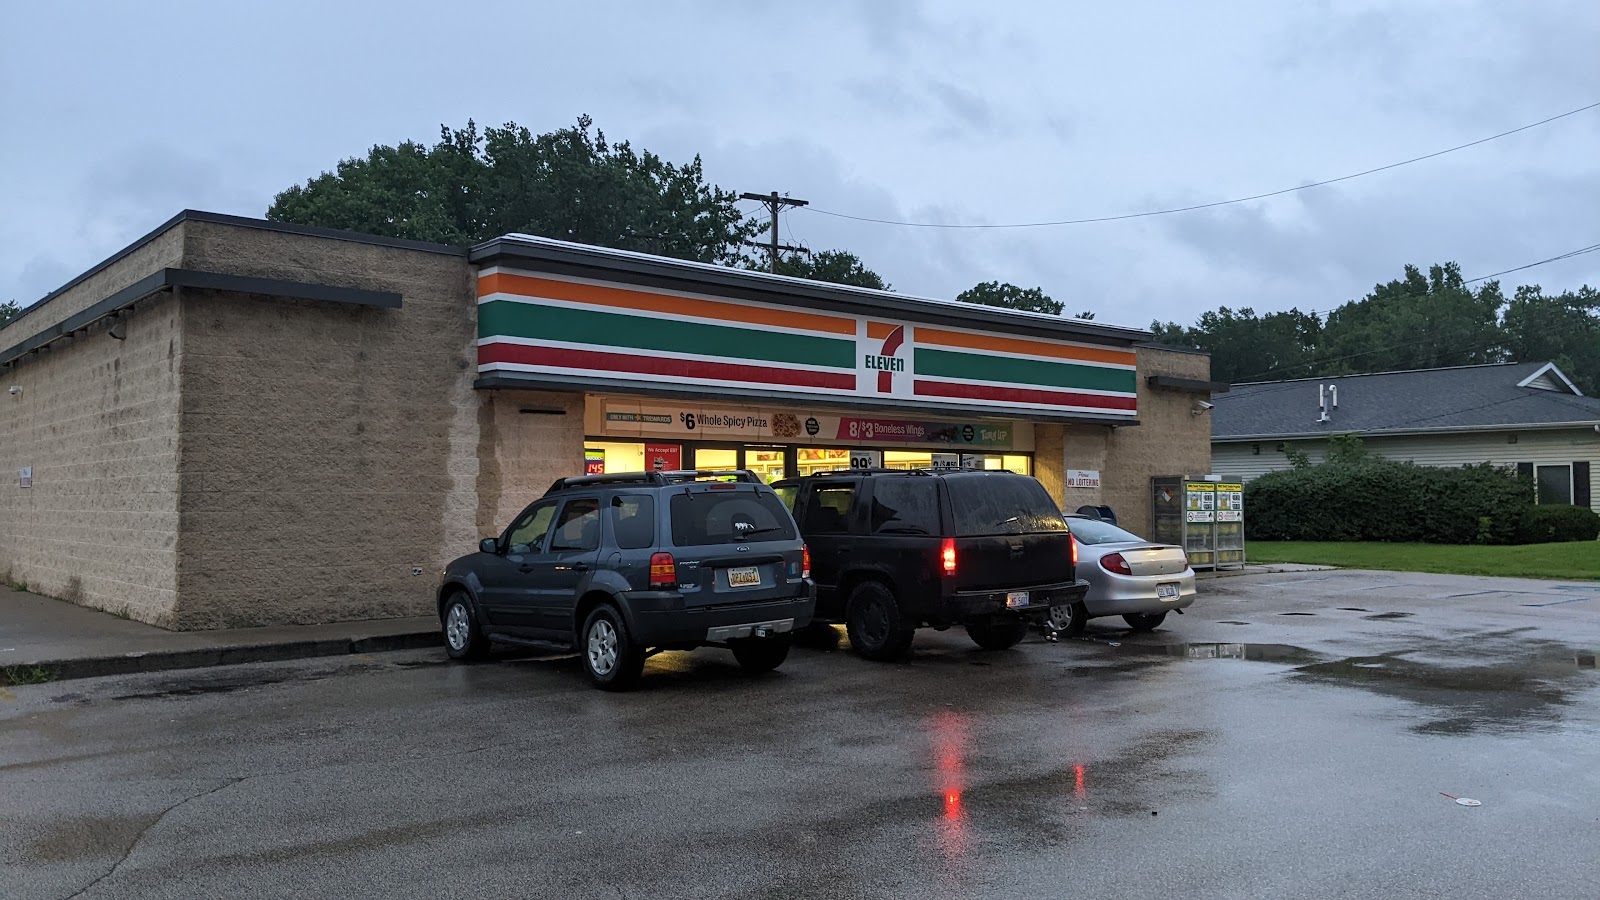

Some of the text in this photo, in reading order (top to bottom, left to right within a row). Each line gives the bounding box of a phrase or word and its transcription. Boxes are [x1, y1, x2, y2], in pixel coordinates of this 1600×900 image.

[877, 325, 904, 393] 7
[680, 412, 768, 430] $6 Whole Spicy Pizza
[874, 423, 905, 434] Boneless
[905, 424, 925, 436] Wings
[1067, 478, 1099, 487] NO LOITERING
